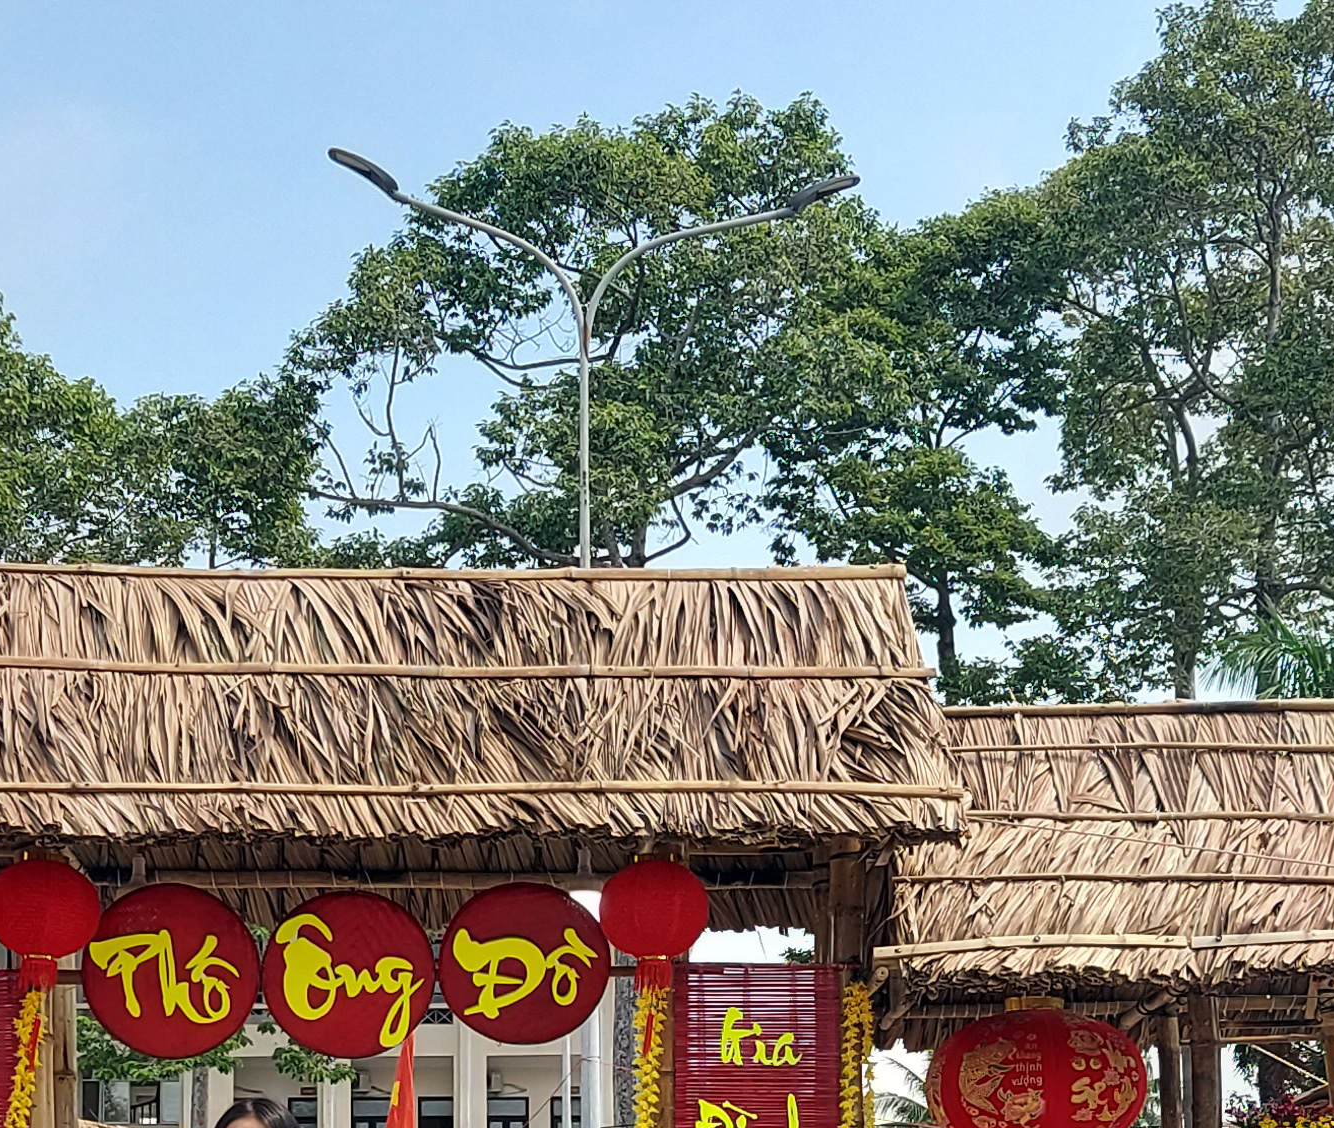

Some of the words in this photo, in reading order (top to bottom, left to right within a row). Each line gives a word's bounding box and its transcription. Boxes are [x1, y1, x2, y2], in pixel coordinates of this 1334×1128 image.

[276, 913, 425, 1048] Ông
[452, 928, 599, 1019] Đồ
[720, 1007, 803, 1067] Gia
[1015, 1061, 1043, 1076] thịnh
